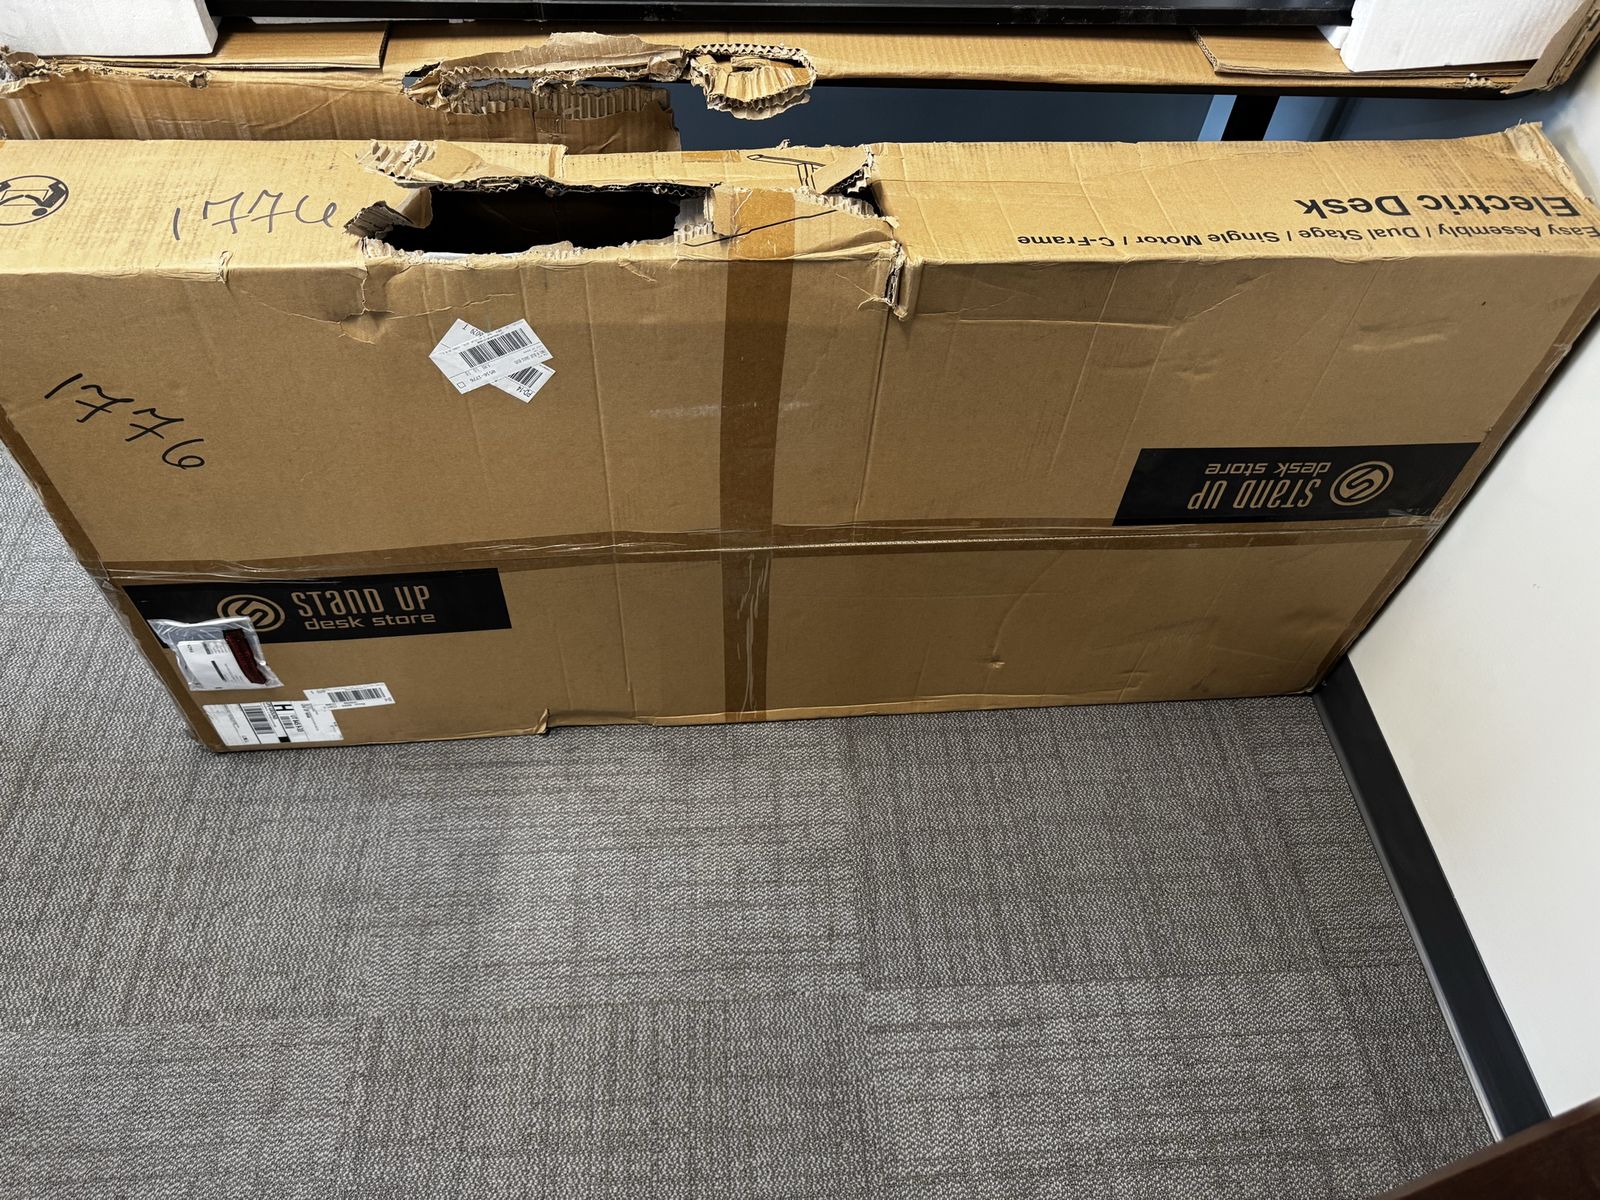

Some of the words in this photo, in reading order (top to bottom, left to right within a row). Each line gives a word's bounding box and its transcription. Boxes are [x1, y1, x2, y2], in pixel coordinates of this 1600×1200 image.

[1295, 195, 1412, 219] Desk
[1416, 194, 1581, 217] Electric
[172, 190, 338, 241] 1776
[1207, 229, 1281, 244] Single
[1298, 226, 1364, 241] Stage
[1370, 226, 1420, 240] Dual
[1437, 223, 1542, 239] Assembly
[1547, 223, 1600, 238] Easy
[1017, 236, 1115, 247] C-Frame
[1136, 234, 1203, 247] Motor
[44, 372, 206, 469] 1776
[1204, 462, 1269, 477] store
[1273, 461, 1333, 478] desk
[1187, 479, 1228, 510] UP
[393, 584, 431, 612] UP
[303, 615, 366, 630] desk
[372, 612, 437, 627] store
